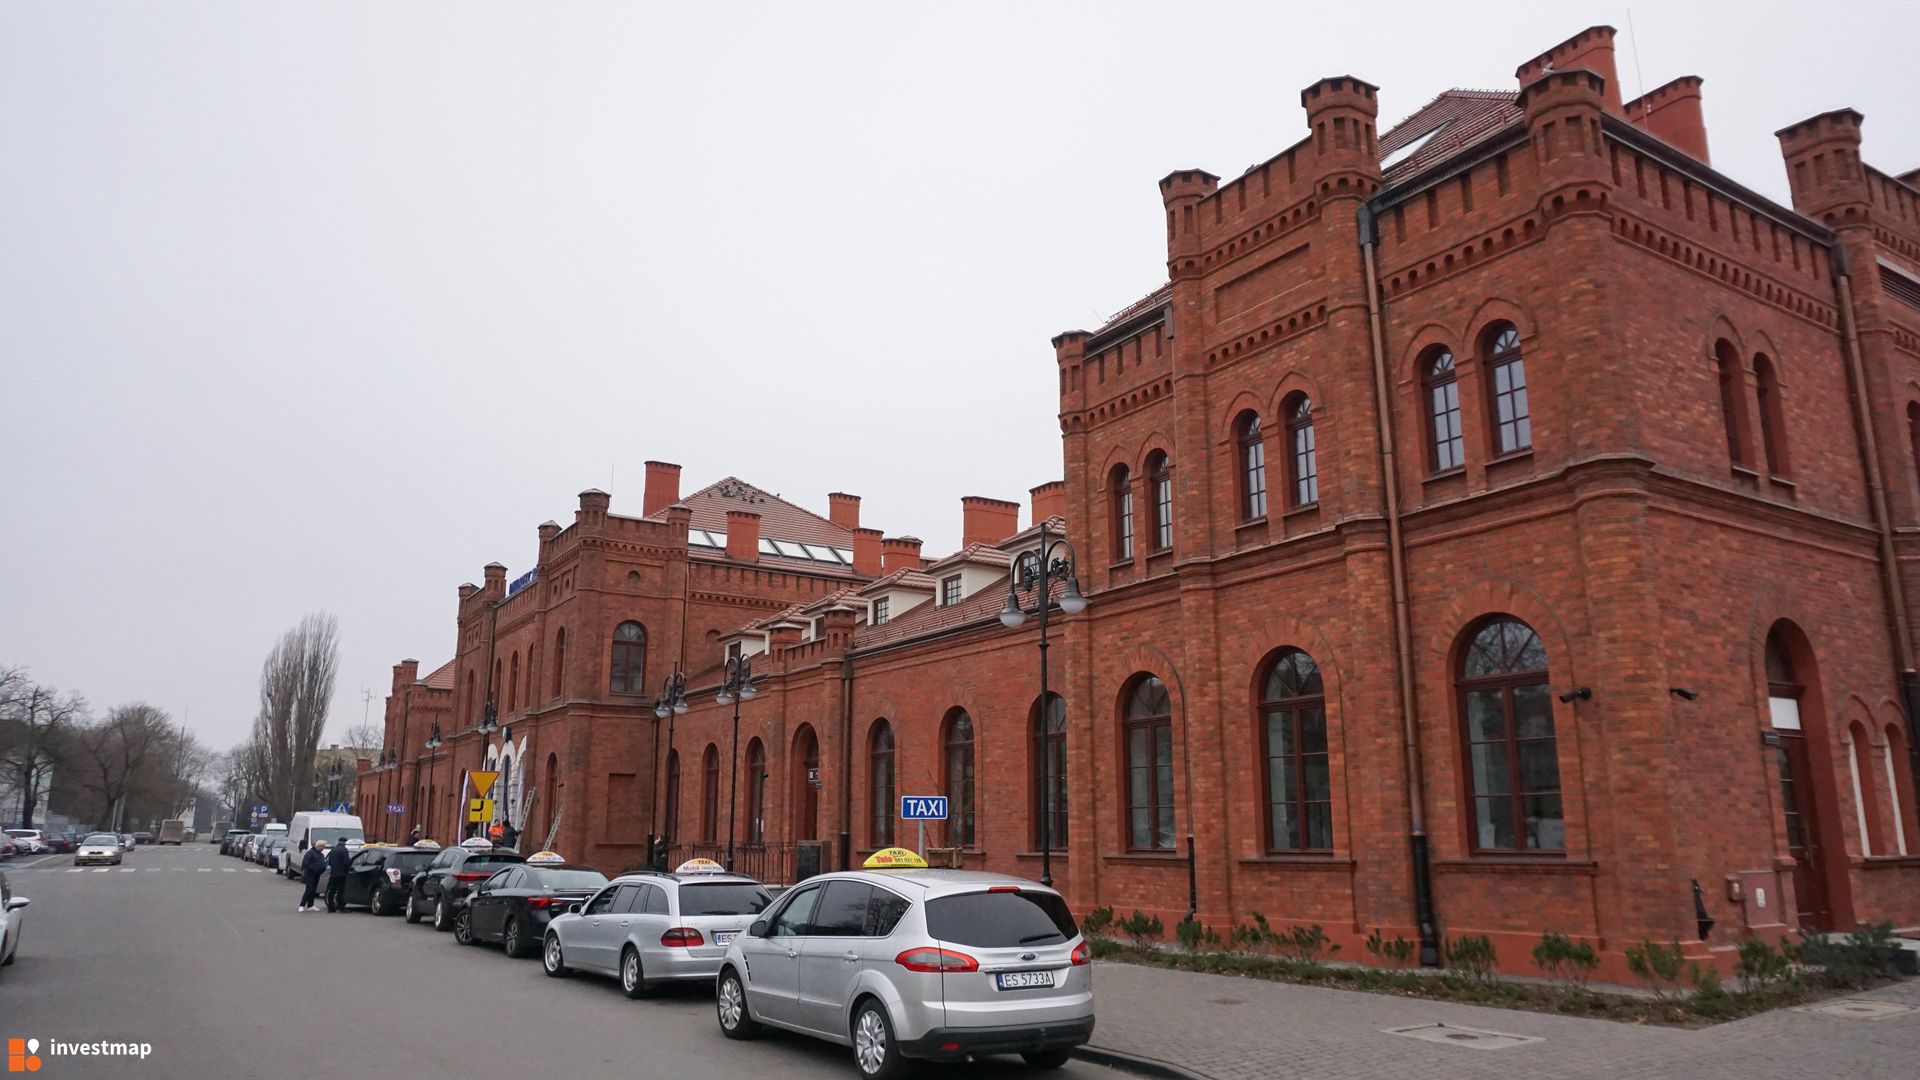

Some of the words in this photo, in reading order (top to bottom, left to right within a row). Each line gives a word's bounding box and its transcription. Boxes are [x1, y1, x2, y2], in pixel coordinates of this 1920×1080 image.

[389, 805, 404, 813] TAXI
[907, 799, 943, 816] TAXI
[1005, 974, 1018, 986] ES
[1021, 972, 1051, 985] 5733A
